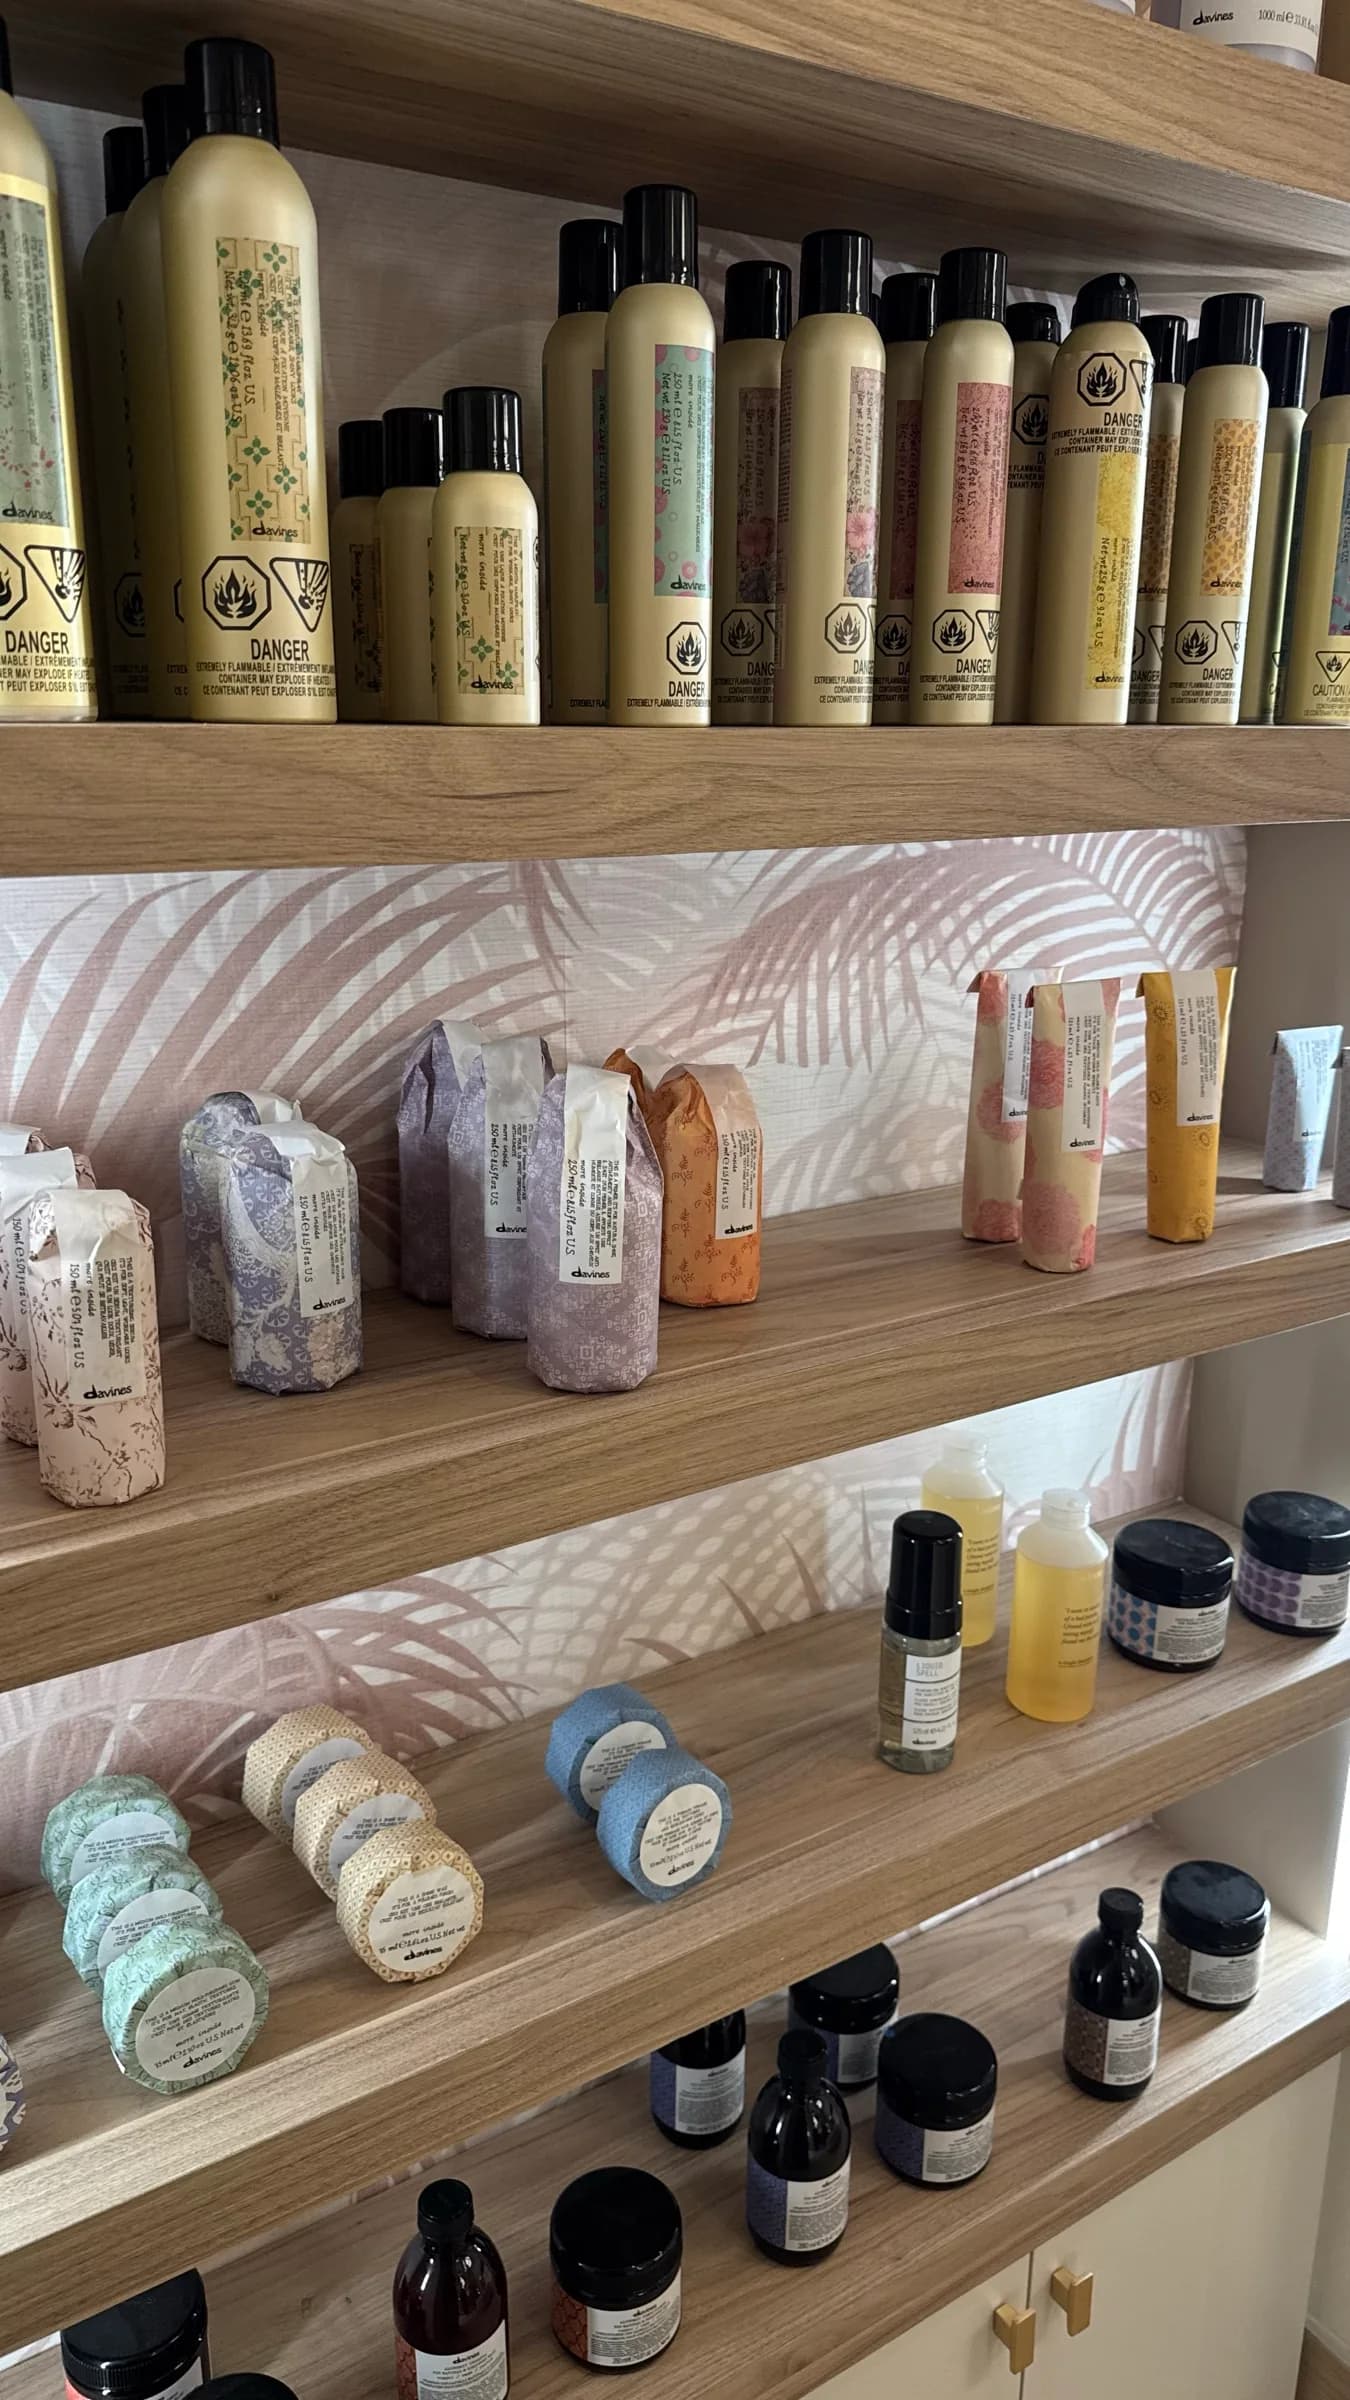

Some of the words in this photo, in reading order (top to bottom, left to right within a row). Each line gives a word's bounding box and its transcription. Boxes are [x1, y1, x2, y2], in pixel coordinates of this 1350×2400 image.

[1193, 11, 1234, 25] davines
[1258, 10, 1275, 21] 1000
[661, 372, 671, 390] Net
[673, 391, 683, 405] ml
[687, 401, 695, 428] inside
[1104, 412, 1142, 428] DANGER
[1078, 427, 1115, 436] FLAMMABLE
[1069, 437, 1103, 445] CONTAINER
[1061, 446, 1095, 455] CONTENANT
[1097, 445, 1112, 453] PEUT
[2, 501, 53, 522] davines
[253, 520, 298, 538] davines
[1100, 537, 1110, 555] Net
[479, 561, 487, 591] inside
[671, 574, 707, 590] davines
[963, 576, 995, 589] davines
[6, 631, 69, 654] DANGER
[251, 638, 310, 661] DANGER
[196, 662, 226, 673] EXTREMELY
[228, 662, 271, 673] FLAMMABLE
[748, 661, 775, 676] DANG
[956, 659, 991, 674] DANGER
[15, 668, 32, 678] MAY
[33, 668, 65, 678] EXPLODE
[1096, 672, 1125, 684] davines
[1132, 671, 1160, 682] DANGER
[1203, 668, 1233, 680] DANGER
[218, 674, 258, 684] CONTAINER
[259, 674, 280, 684] MAY
[281, 675, 306, 685] EXPLODE
[471, 675, 513, 689] davines
[7, 680, 28, 691] PEUT
[30, 681, 67, 692] EXPLOSER
[203, 687, 211, 695] CE
[211, 686, 248, 696] CONTENANT
[249, 686, 267, 696] PEUT
[268, 686, 307, 696] EXPLOSER
[669, 681, 705, 698] DANGER
[936, 684, 961, 692] CONTAINER
[1313, 684, 1344, 696] CAUTION
[929, 693, 955, 701] CONTENANT
[627, 699, 653, 708] EXTREMELY
[654, 699, 683, 708] FLAMMABLE
[1187, 1112, 1213, 1121] davines
[490, 1123, 499, 1137] 250
[490, 1138, 499, 1148] ml
[1069, 1137, 1095, 1148] davines
[568, 1159, 577, 1175] 250
[490, 1180, 497, 1189] oz
[568, 1176, 577, 1190] ml
[301, 1210, 309, 1222] ml
[496, 1222, 527, 1233] davine
[566, 1225, 574, 1236] oz
[724, 1224, 753, 1234] davines
[14, 1233, 24, 1244] ml
[303, 1256, 311, 1265] oz
[70, 1264, 80, 1279] 150
[571, 1266, 610, 1278] davines
[70, 1280, 81, 1294] ml
[87, 1289, 96, 1317] inside
[312, 1297, 346, 1310] davines
[74, 1337, 82, 1348] oz
[83, 1384, 133, 1399] davines
[402, 1927, 419, 1937] more
[404, 1947, 442, 1961] davines
[176, 2035, 194, 2047] more
[198, 2021, 222, 2037] inside
[183, 2047, 222, 2068] davines
